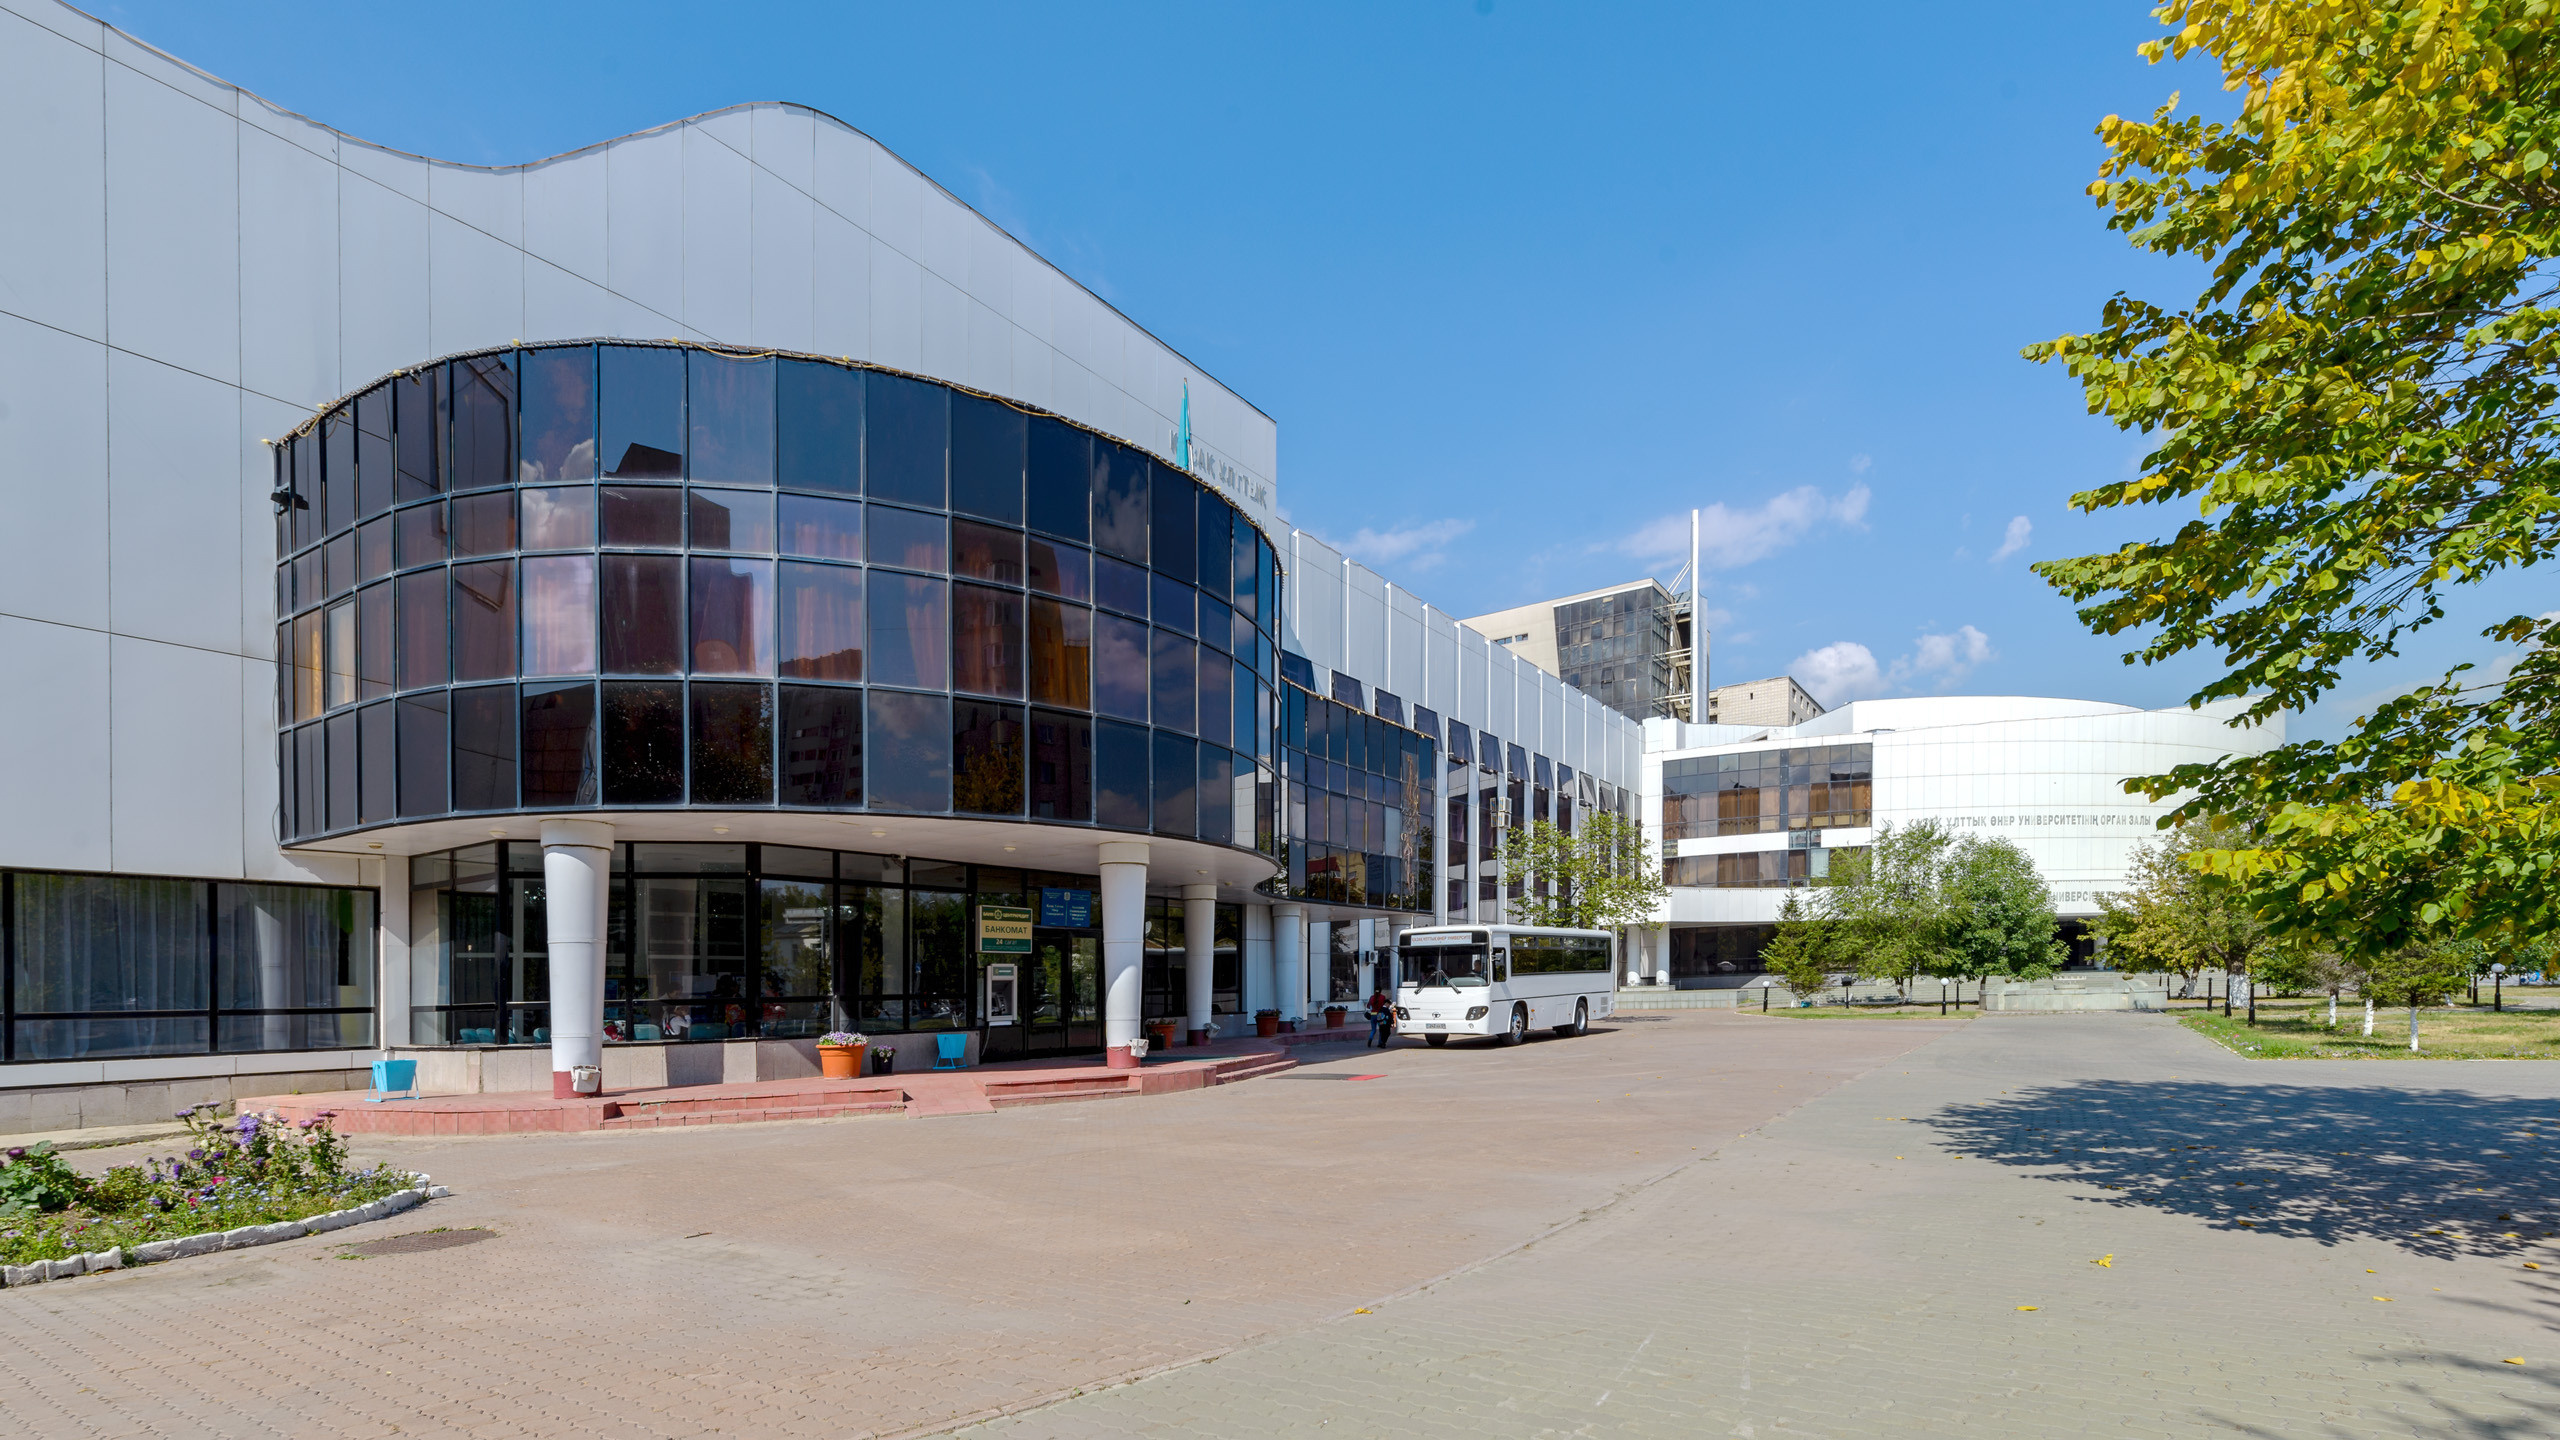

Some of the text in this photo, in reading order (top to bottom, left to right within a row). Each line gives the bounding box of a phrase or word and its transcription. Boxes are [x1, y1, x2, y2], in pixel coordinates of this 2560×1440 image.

[1946, 816, 1987, 827] ҰЛТТЫҚ
[1990, 815, 2015, 826] ӨНЕР
[2018, 814, 2099, 827] УНИВЕРСИТЕТІНІҢ
[2100, 815, 2127, 825] ОРГАН
[2129, 815, 2151, 826] ЗАЛЫ
[985, 925, 1027, 934] БАНКОМАТ
